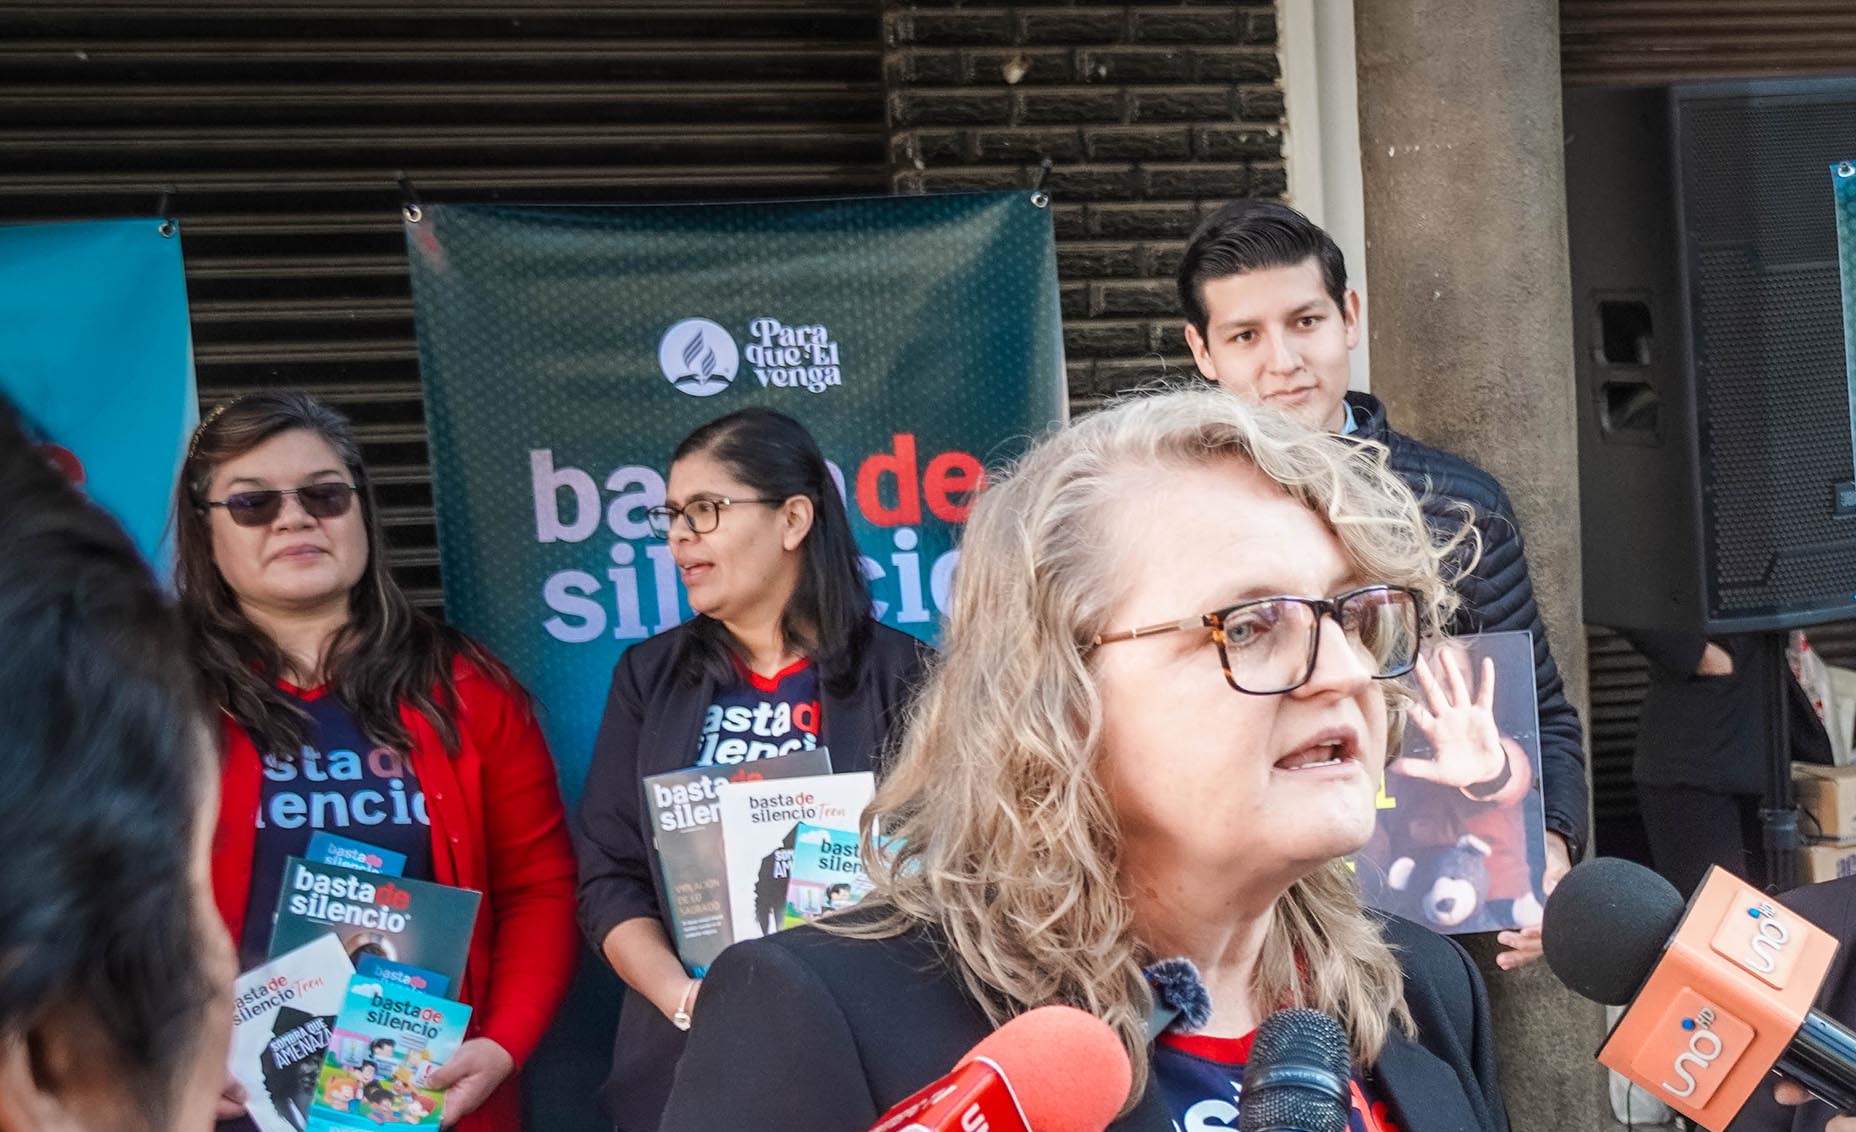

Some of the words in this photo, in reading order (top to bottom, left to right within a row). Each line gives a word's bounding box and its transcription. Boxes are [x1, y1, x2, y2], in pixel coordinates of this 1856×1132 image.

[748, 317, 829, 347] Para
[745, 344, 802, 369] que
[807, 342, 840, 367] El
[753, 364, 842, 394] venga
[751, 806, 816, 824] silencio
[233, 988, 296, 1026] silencio
[234, 975, 288, 1009] astade
[367, 1010, 438, 1040] silencio
